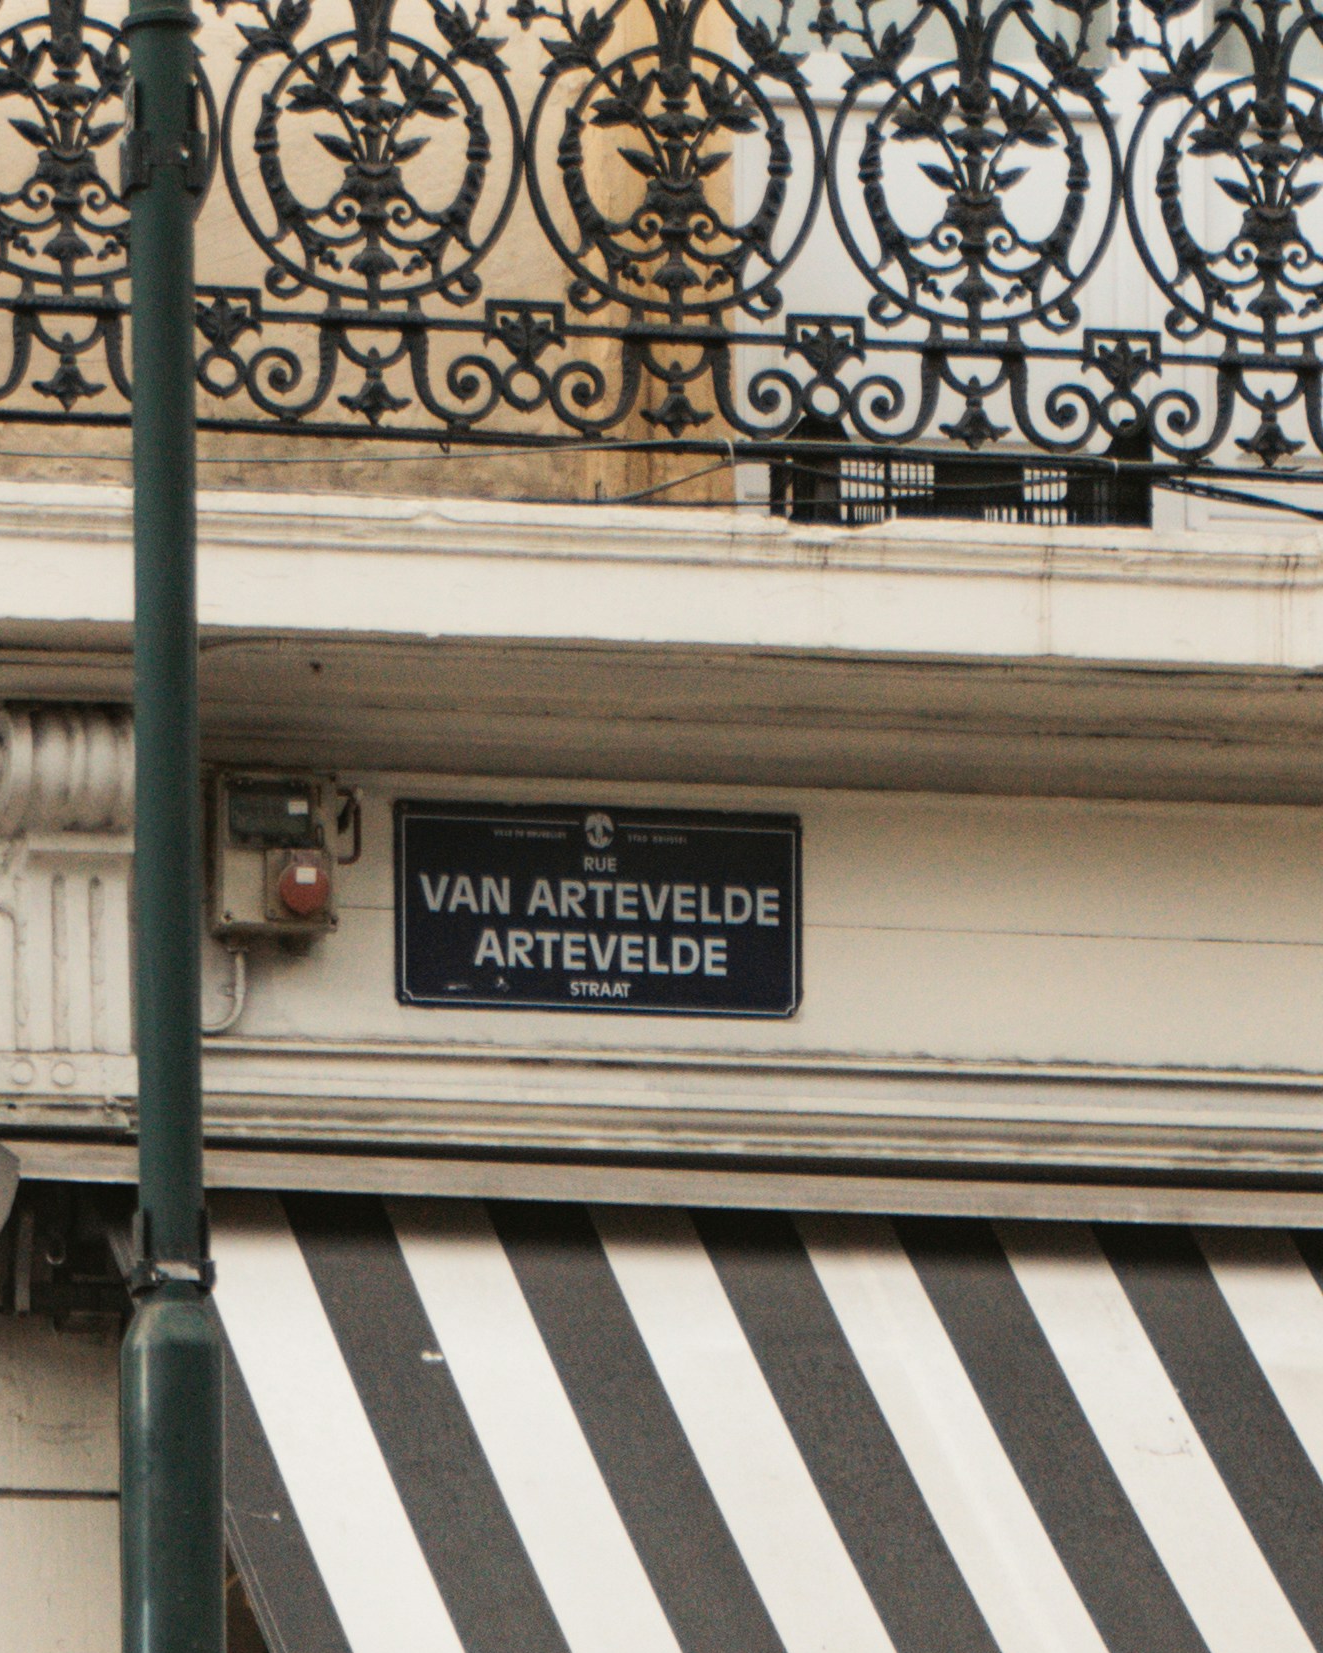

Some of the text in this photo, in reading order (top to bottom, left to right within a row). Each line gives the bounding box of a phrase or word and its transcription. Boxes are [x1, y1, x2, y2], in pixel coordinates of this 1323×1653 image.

[584, 855, 617, 873] RUE
[420, 873, 780, 927] VAN ARTEVELDE
[474, 929, 728, 977] ARTEVELDE
[569, 980, 632, 998] STRAAT
